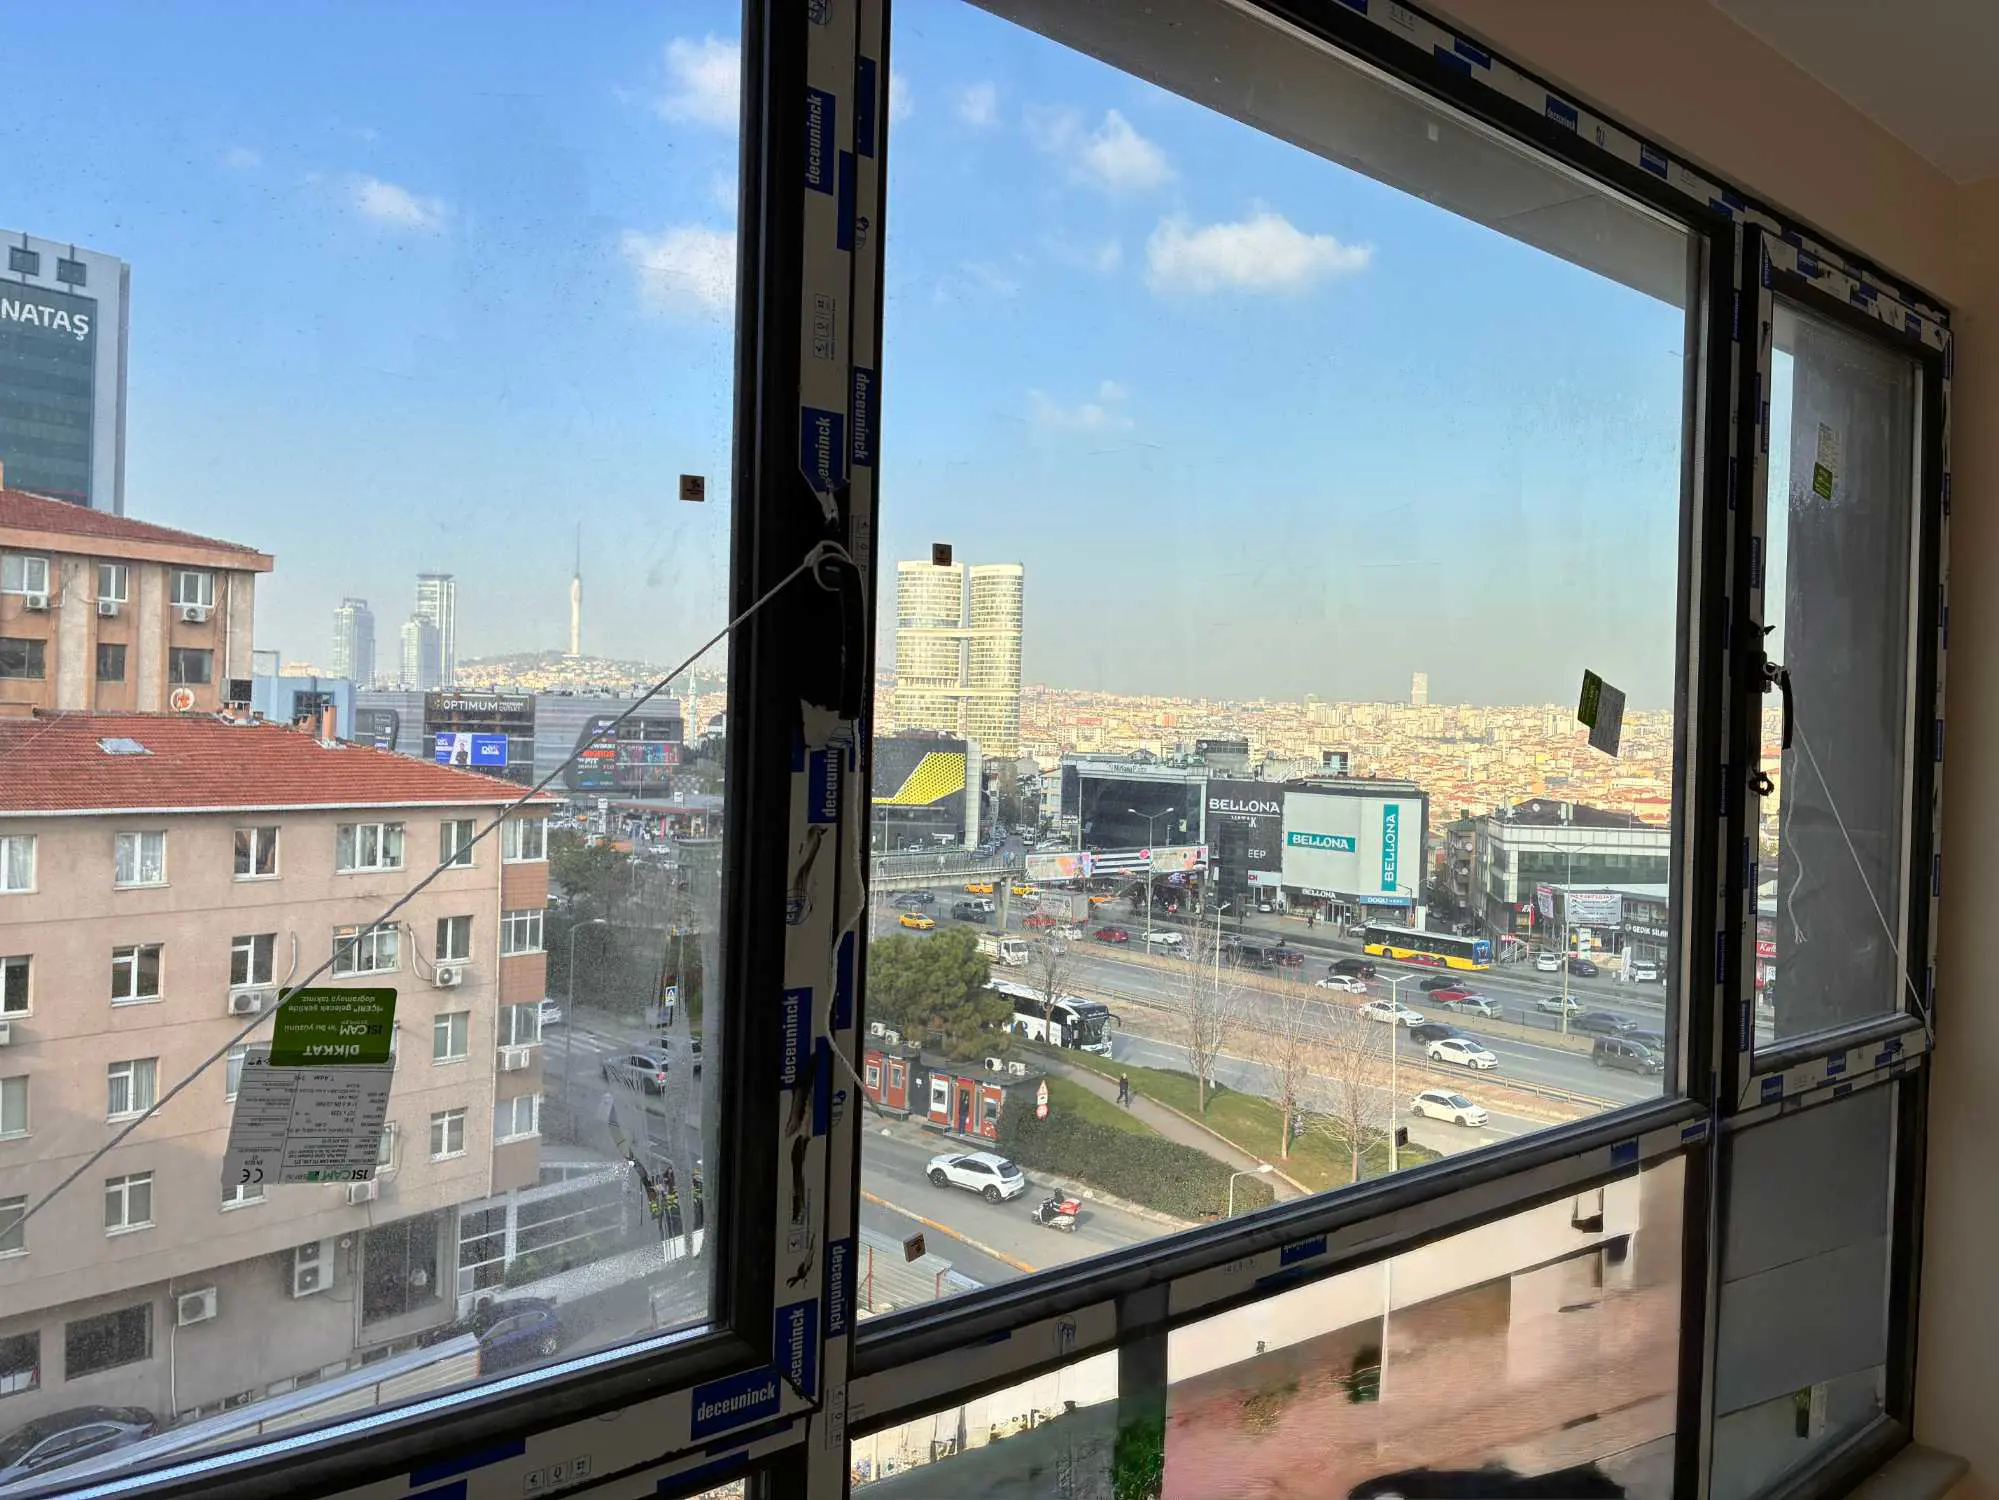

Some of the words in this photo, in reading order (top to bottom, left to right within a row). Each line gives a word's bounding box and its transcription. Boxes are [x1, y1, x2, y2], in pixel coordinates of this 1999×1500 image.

[806, 94, 824, 185] deceuninck
[1, 298, 90, 341] NATAŞ
[854, 372, 870, 459] deceuninck
[443, 699, 498, 712] OPTIMUM
[1209, 798, 1281, 814] BELLONA
[1292, 834, 1349, 849] BELLONA
[1384, 813, 1396, 882] BELLONA
[1302, 888, 1337, 899] BELLONA
[302, 1044, 360, 1059] DİKKAT
[781, 994, 799, 1085] deceuninck
[830, 1245, 847, 1332] deceuninck
[697, 1381, 776, 1422] deceuninck
